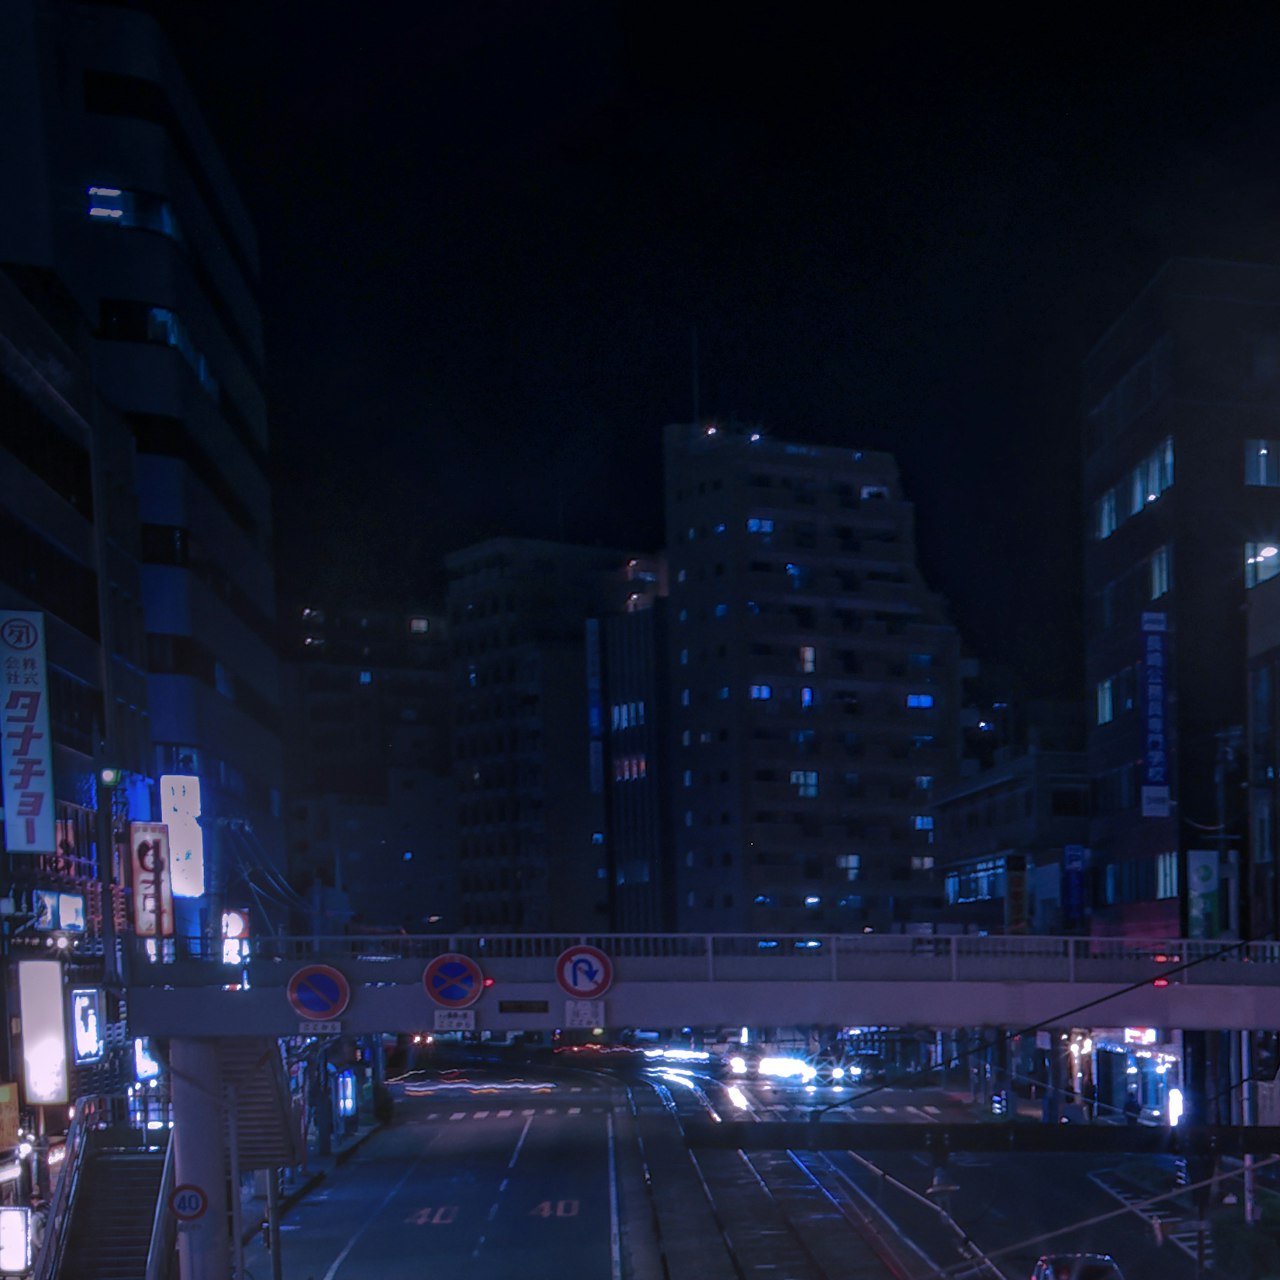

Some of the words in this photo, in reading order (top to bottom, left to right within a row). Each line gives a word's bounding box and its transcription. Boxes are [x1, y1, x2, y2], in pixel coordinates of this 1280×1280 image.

[5, 691, 47, 845] タナチョー
[176, 1194, 200, 1212] 40
[529, 1200, 580, 1218] 40
[403, 1206, 459, 1225] 40
